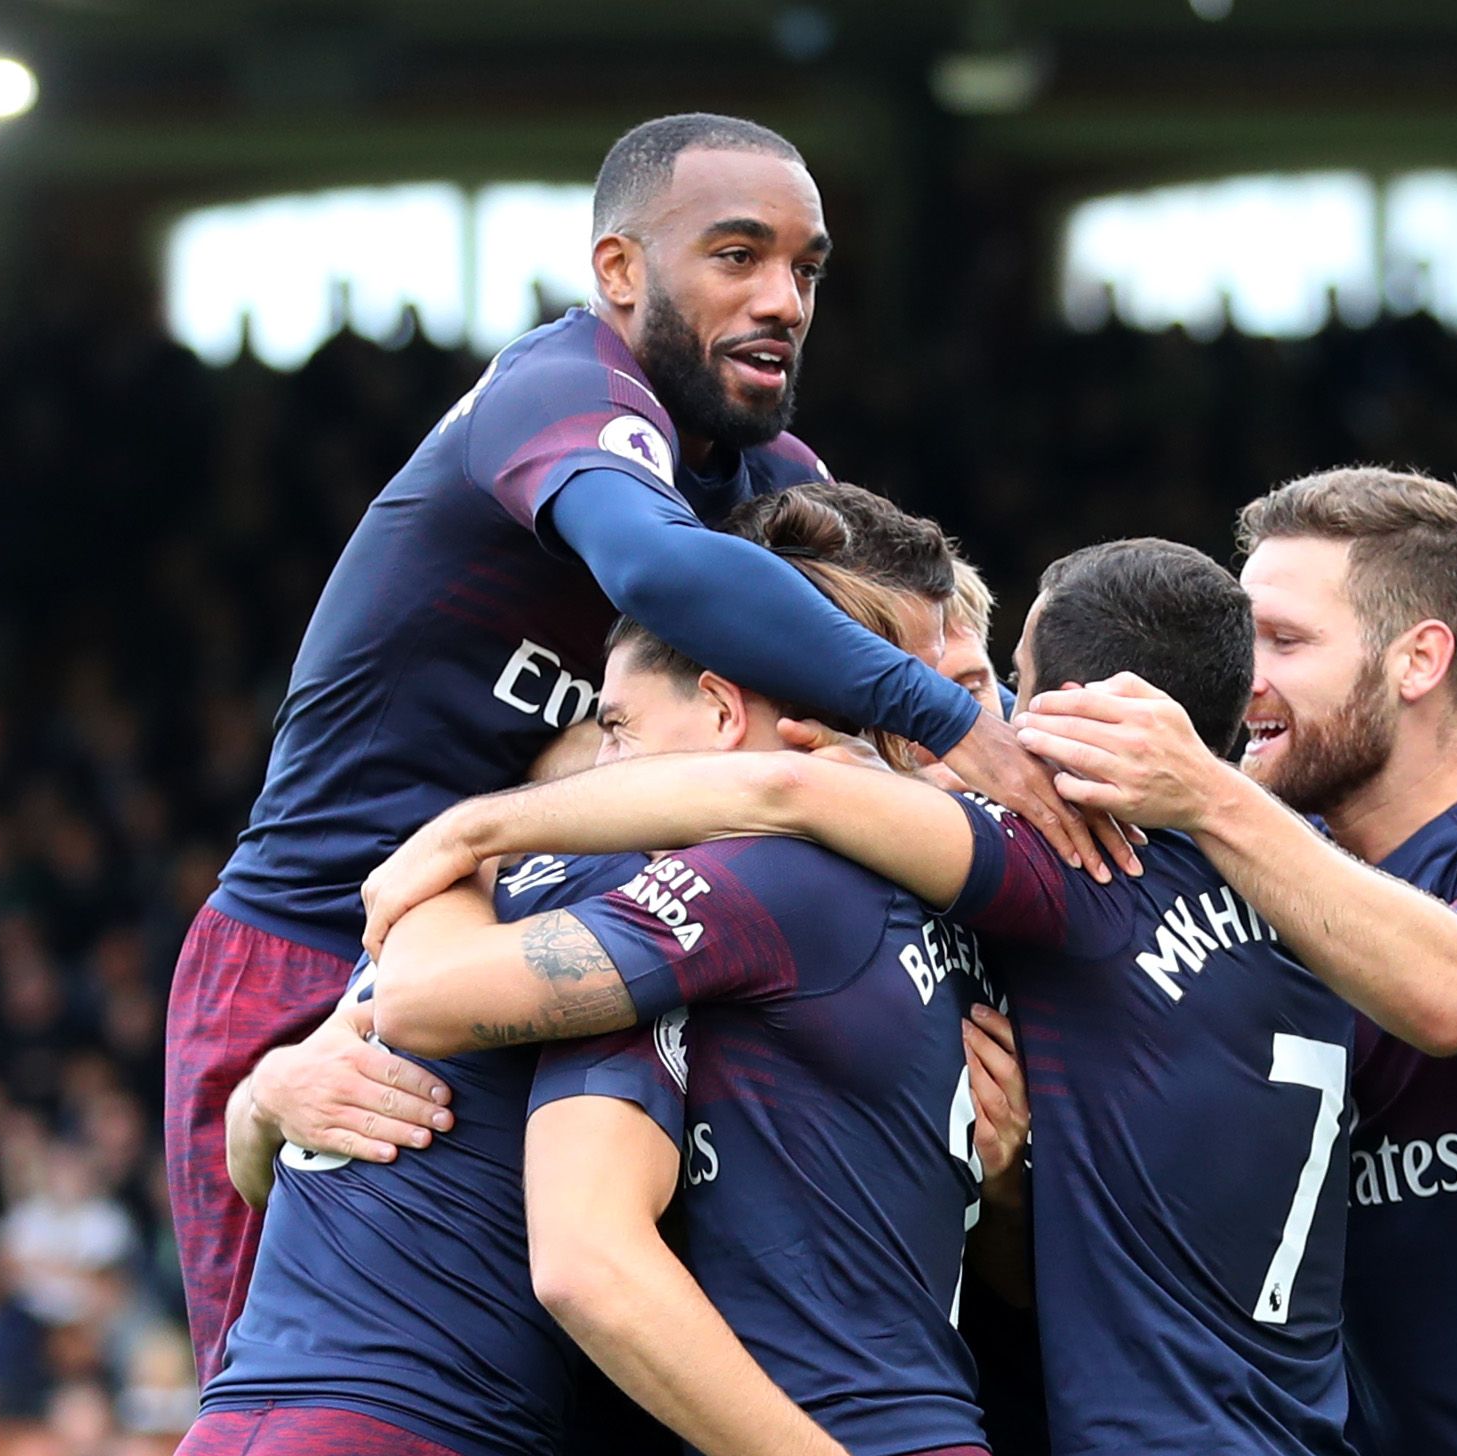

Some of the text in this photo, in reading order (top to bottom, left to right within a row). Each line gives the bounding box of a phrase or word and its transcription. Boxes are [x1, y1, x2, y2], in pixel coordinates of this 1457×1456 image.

[617, 873, 705, 952] ANDA
[1135, 885, 1278, 1002] MKHI
[1252, 1032, 1347, 1325] 7
